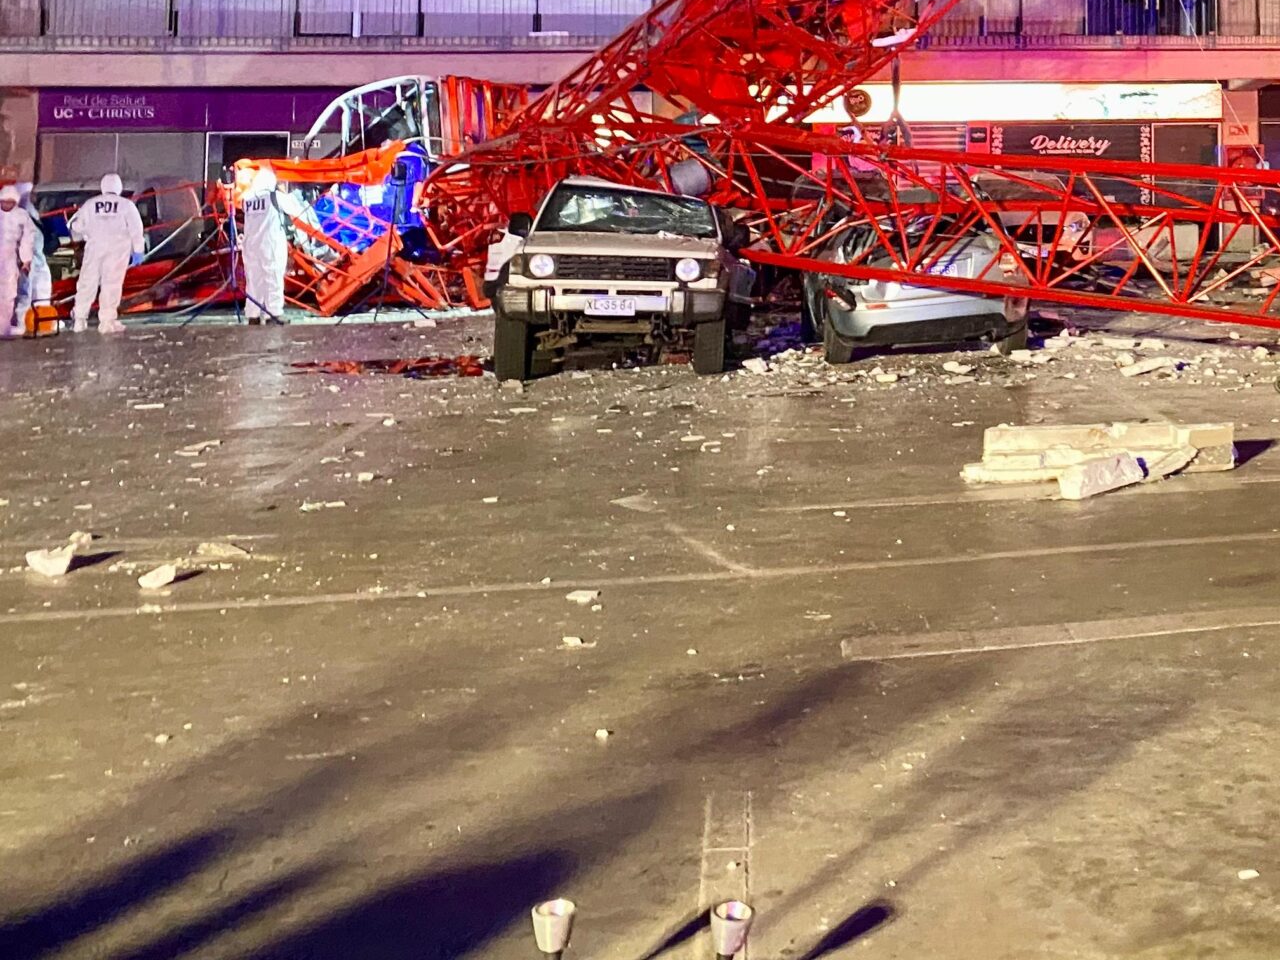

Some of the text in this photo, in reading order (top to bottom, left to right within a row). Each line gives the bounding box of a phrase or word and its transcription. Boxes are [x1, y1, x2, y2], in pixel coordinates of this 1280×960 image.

[63, 94, 146, 105] Red de Salud
[53, 107, 155, 119] UC CHRISTUS
[1030, 134, 1112, 156] Delivery
[94, 201, 119, 214] PDI
[245, 198, 266, 212] PDI
